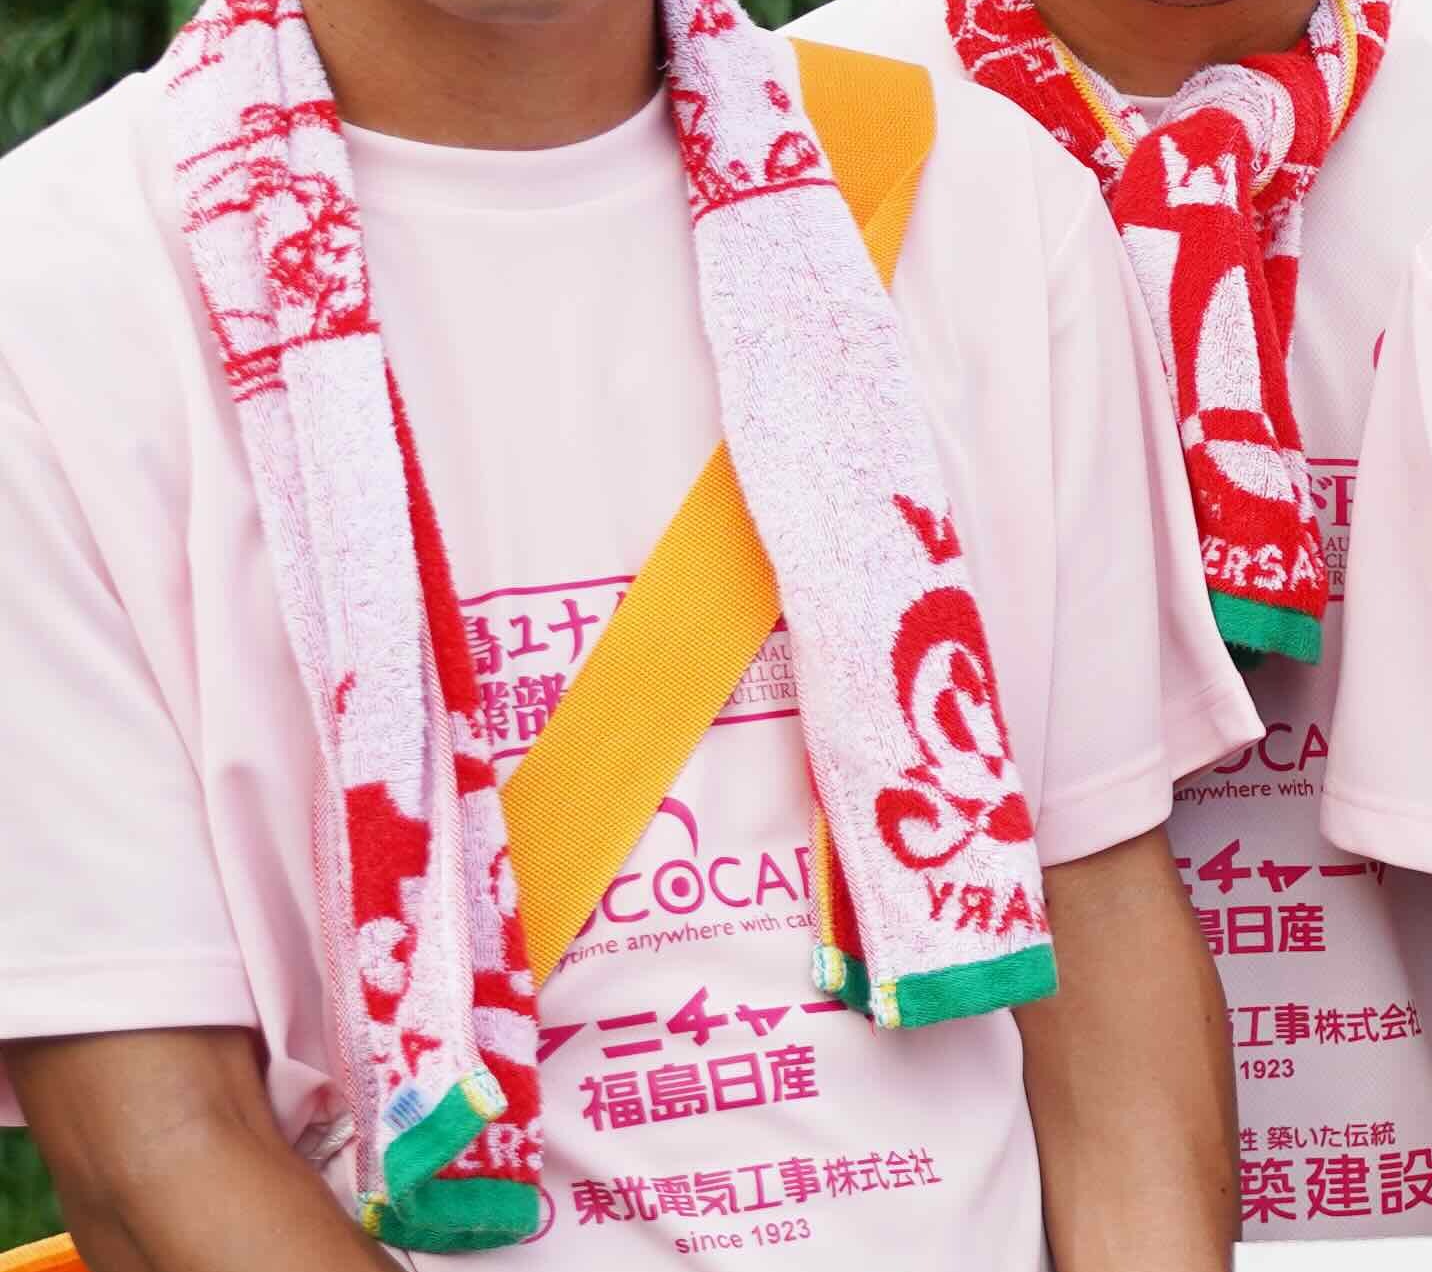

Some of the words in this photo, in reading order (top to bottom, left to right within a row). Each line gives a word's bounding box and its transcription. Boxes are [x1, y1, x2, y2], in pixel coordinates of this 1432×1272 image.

[1278, 778, 1314, 798] with
[627, 920, 735, 953] anywhere
[739, 913, 781, 934] with
[1239, 1057, 1295, 1080] 1923
[578, 1043, 820, 1132] 福島日産
[1267, 1121, 1396, 1151] 築いた伝統
[675, 1230, 744, 1255] since
[750, 1219, 812, 1248] 1923
